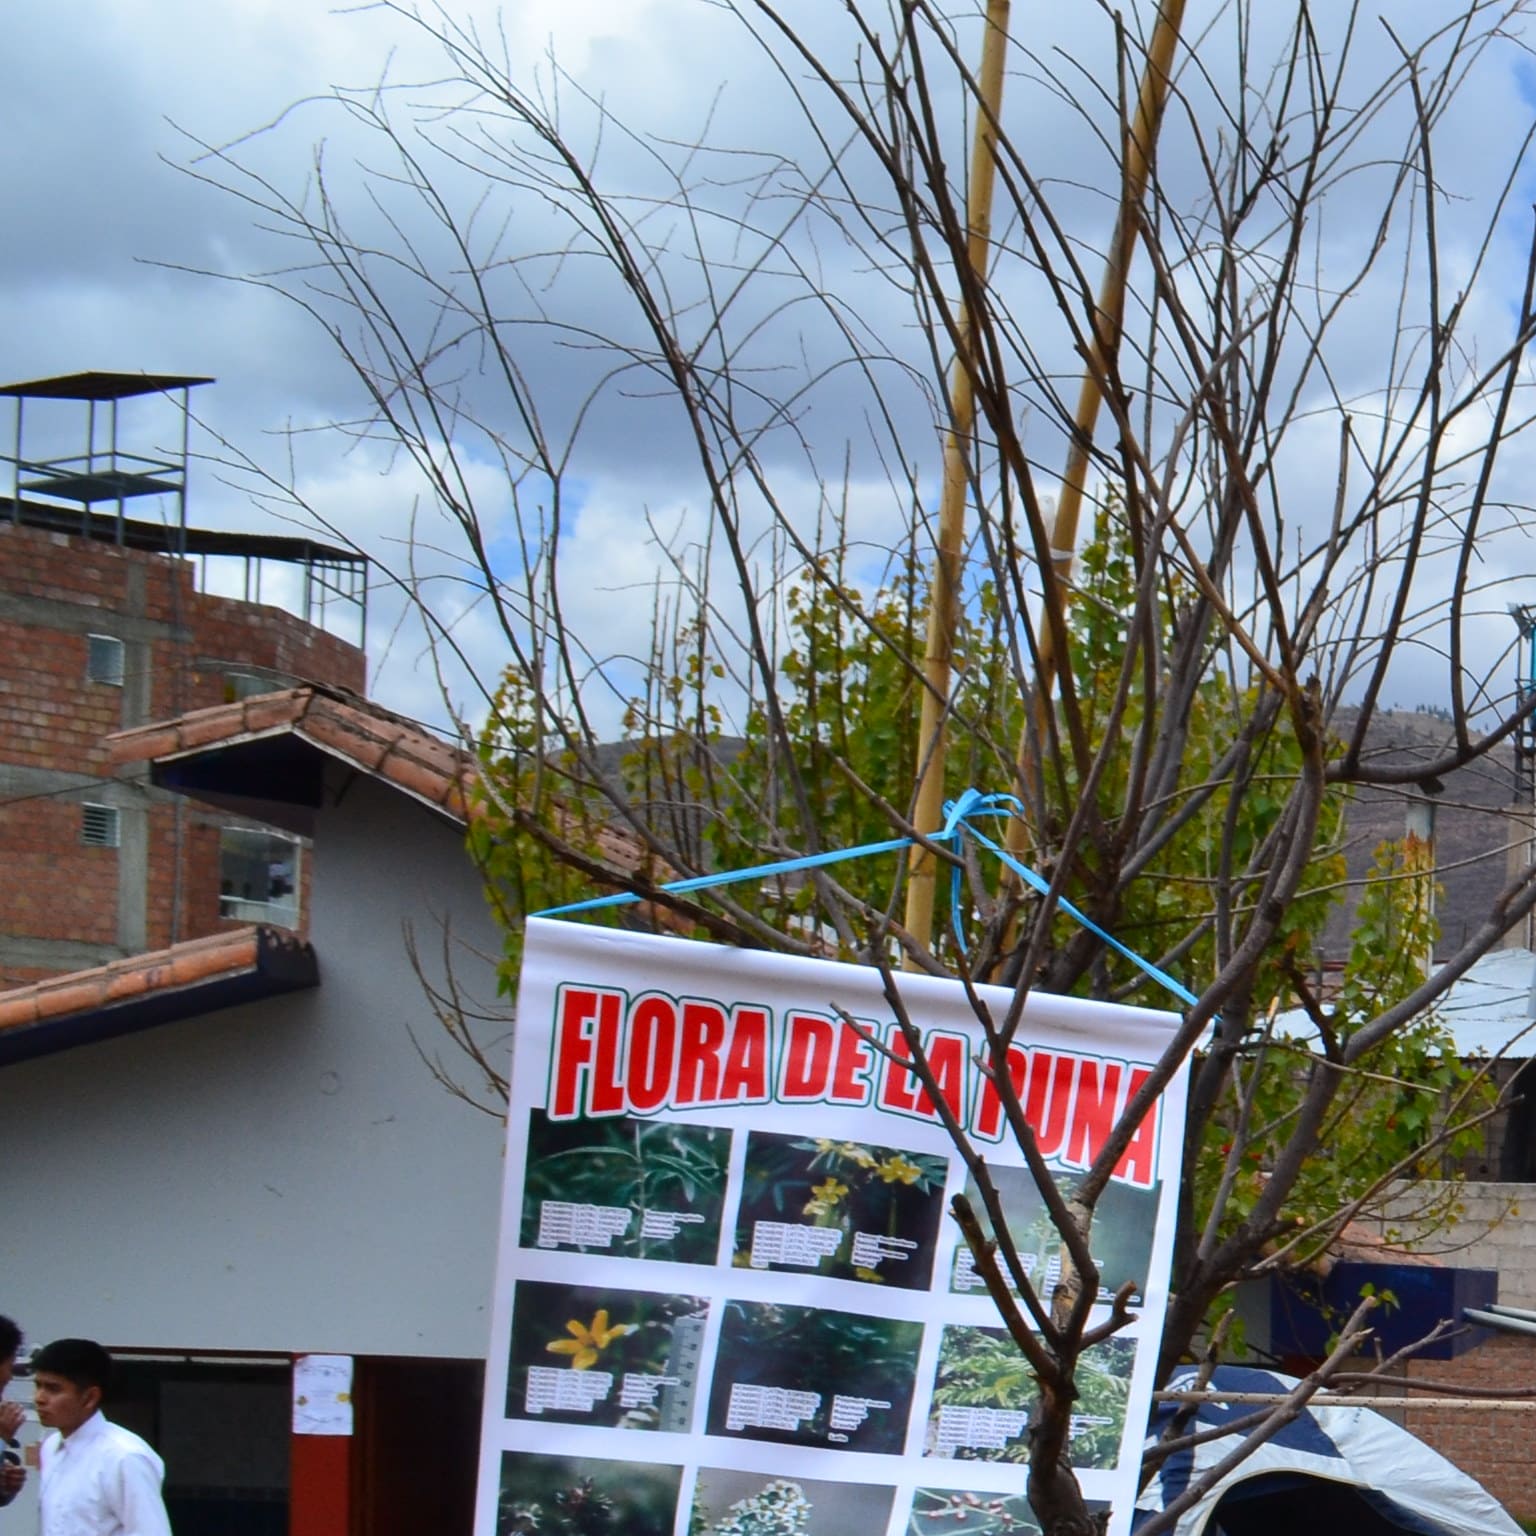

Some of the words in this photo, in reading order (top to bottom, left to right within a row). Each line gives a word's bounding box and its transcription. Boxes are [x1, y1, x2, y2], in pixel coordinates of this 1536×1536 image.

[550, 985, 770, 1118] FLORA
[780, 1013, 877, 1104] DE
[881, 1027, 967, 1128] LA
